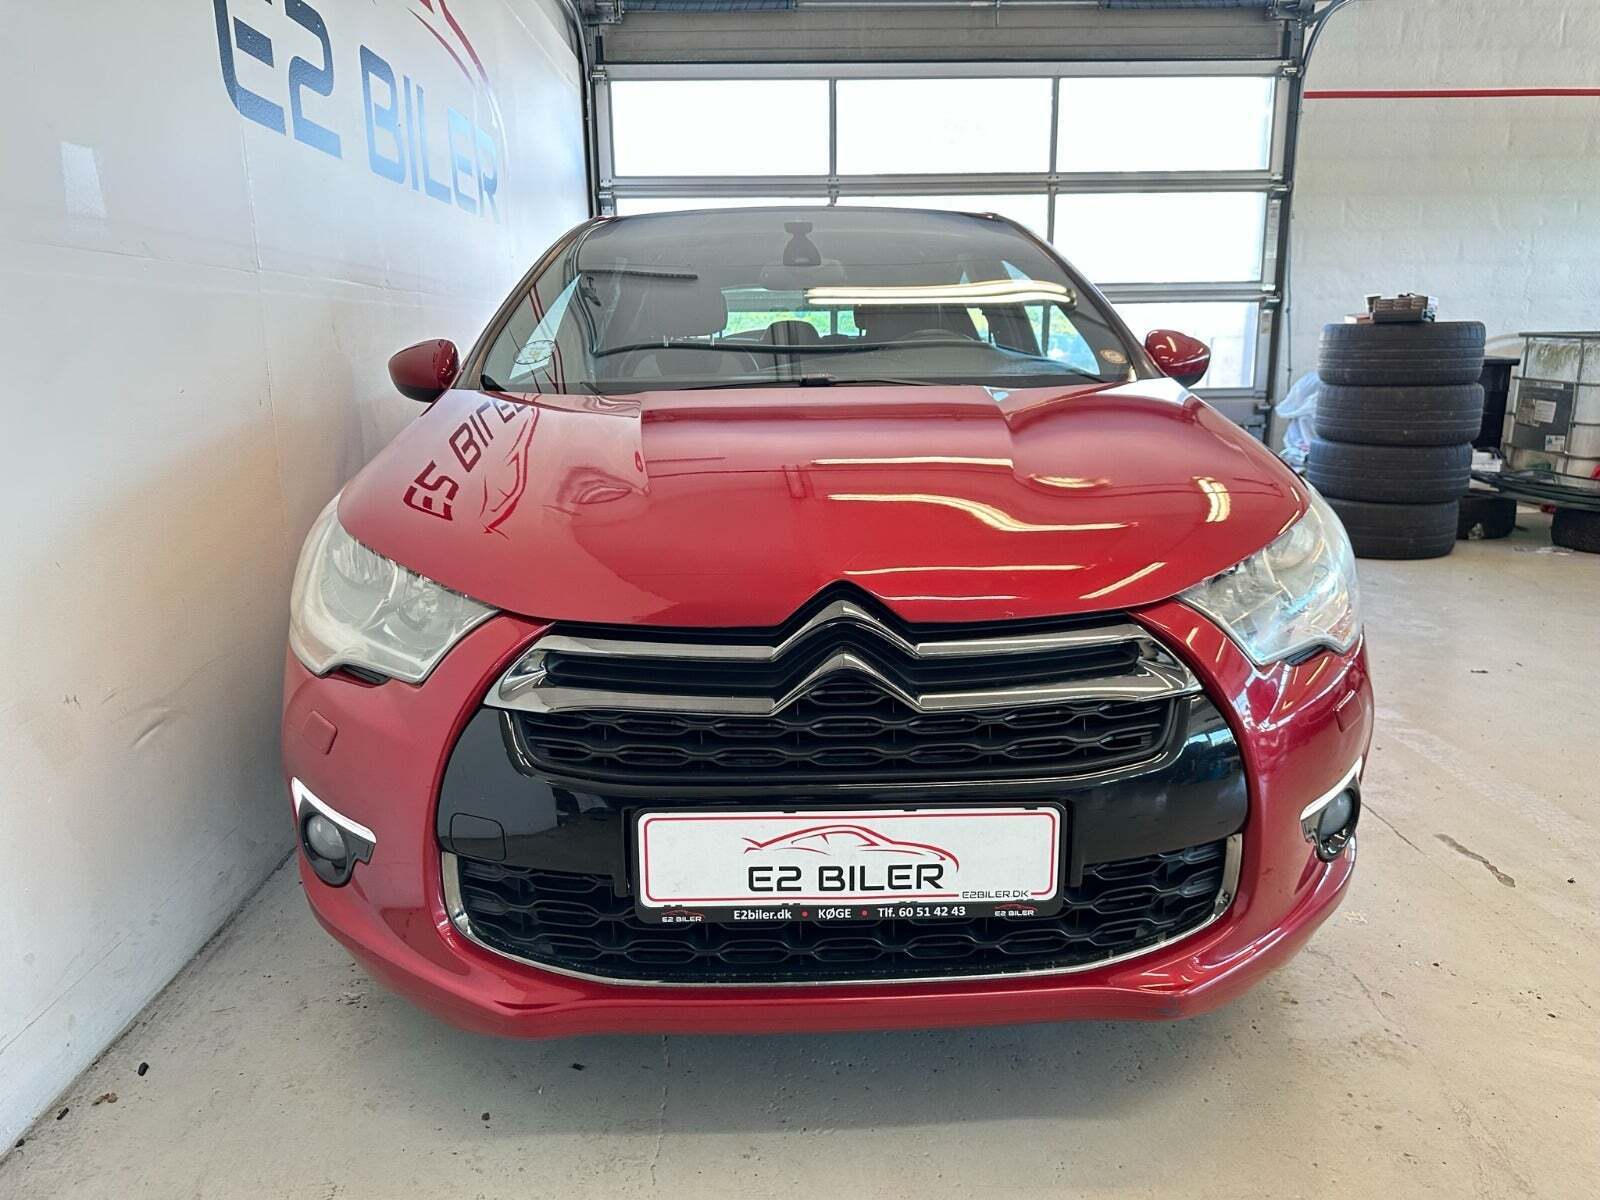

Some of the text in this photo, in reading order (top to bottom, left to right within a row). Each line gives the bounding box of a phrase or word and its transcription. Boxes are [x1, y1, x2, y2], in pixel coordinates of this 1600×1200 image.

[213, 0, 501, 224] E2 BILER
[748, 863, 944, 892] E2 BILER
[962, 889, 1030, 899] E2BILER.DK
[733, 905, 966, 921] E2biler.dk KØGE Tlf. 60 51 42 43
[1008, 909, 1035, 917] BILER
